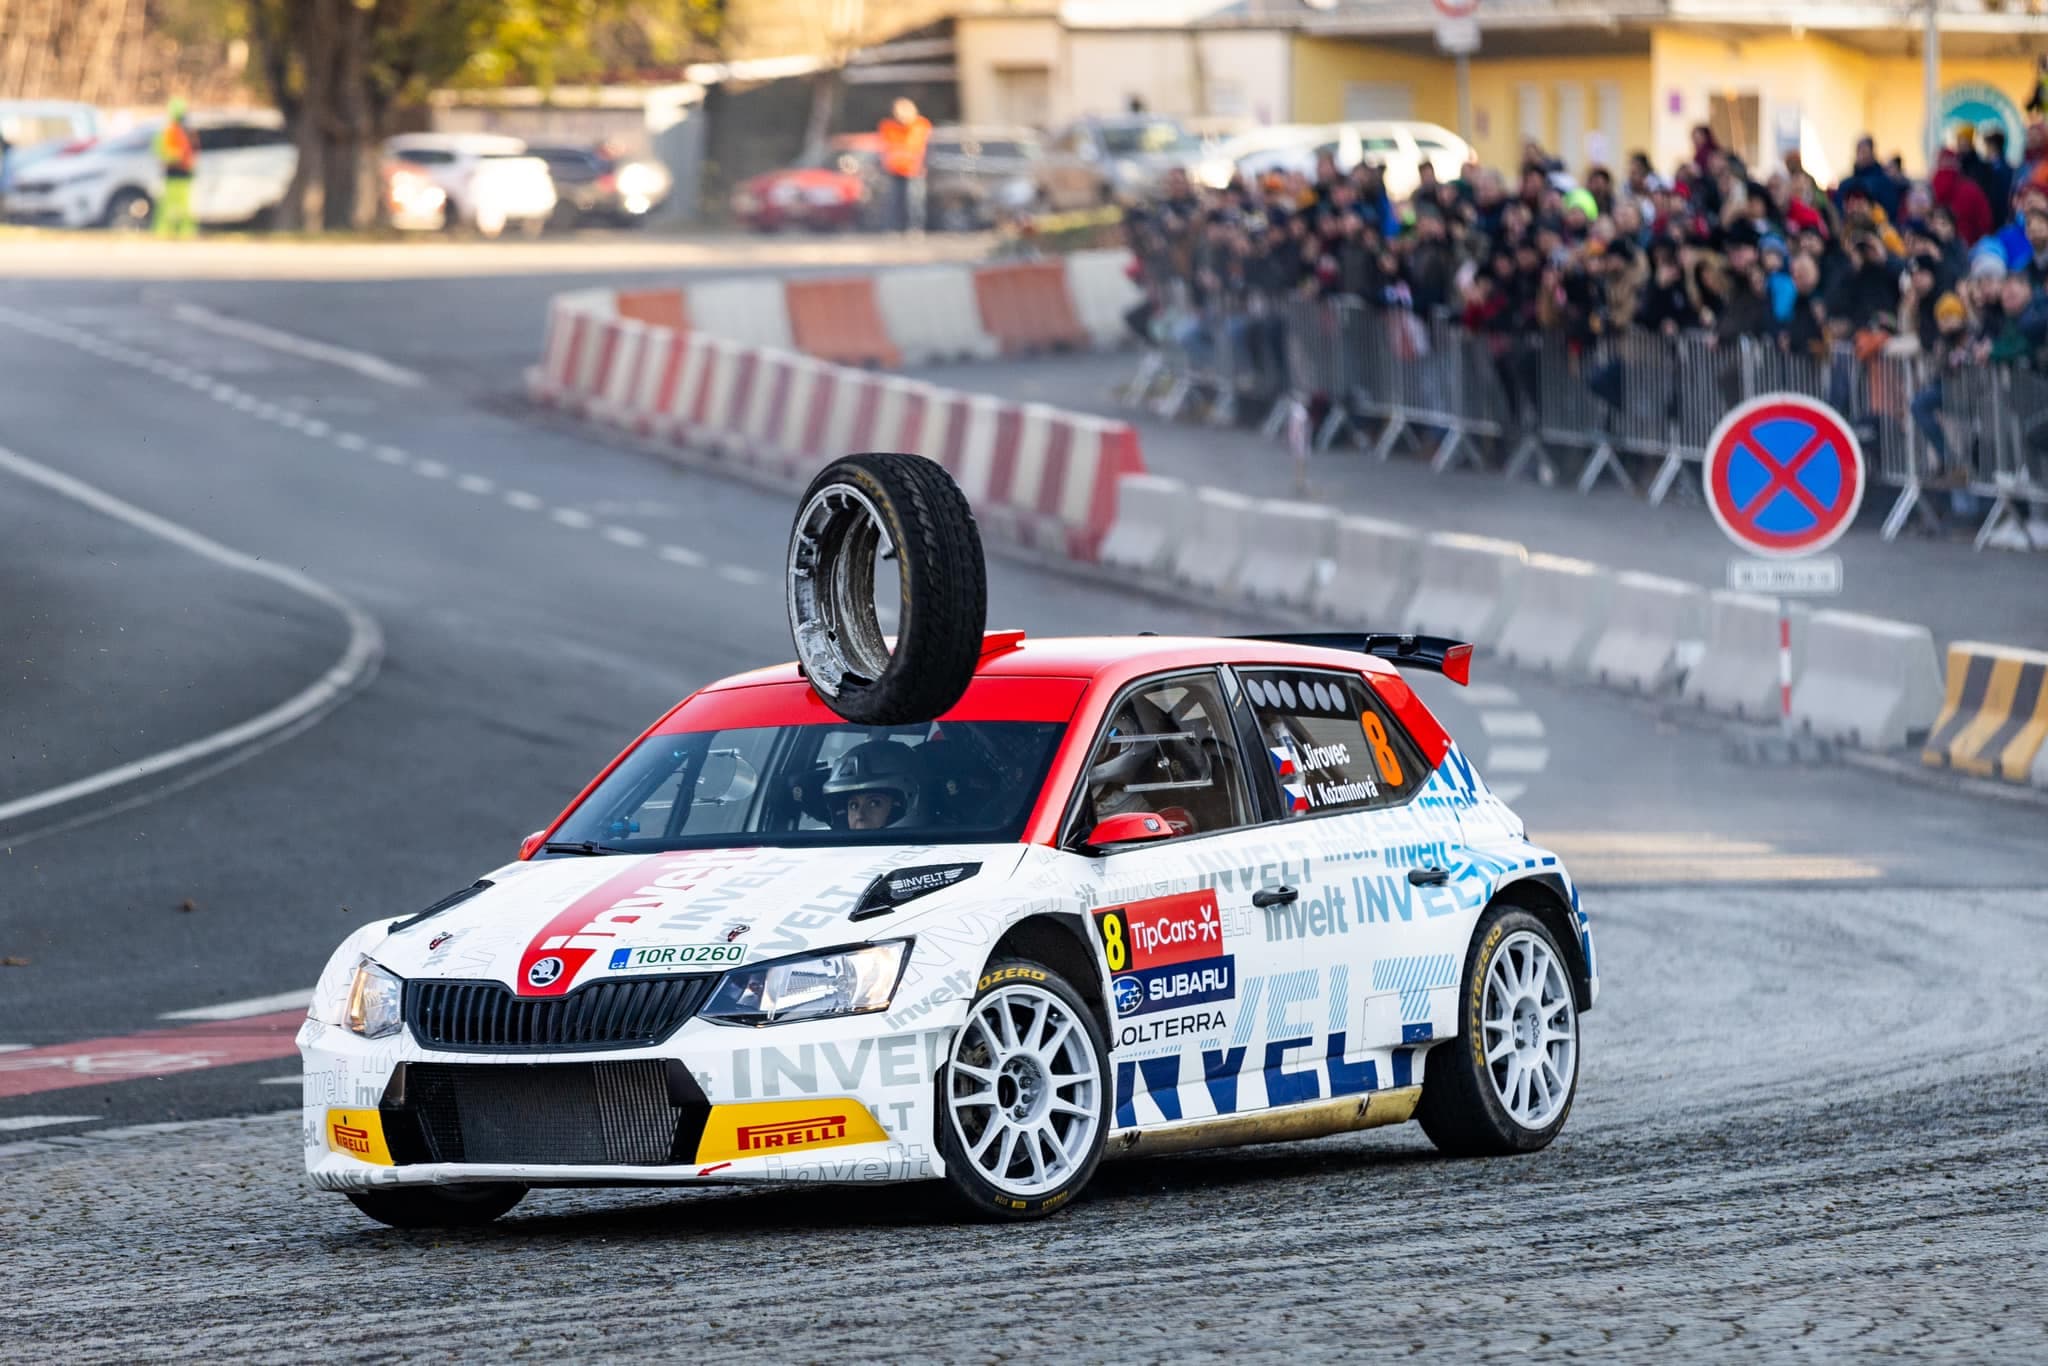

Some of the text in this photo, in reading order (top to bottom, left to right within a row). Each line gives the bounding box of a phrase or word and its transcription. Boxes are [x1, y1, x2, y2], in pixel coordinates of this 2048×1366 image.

[1361, 711, 1403, 786] 8
[903, 872, 945, 888] INVELT
[1103, 913, 1125, 971] 8
[1130, 917, 1197, 954] TipCars
[611, 961, 625, 969] CZ
[636, 946, 742, 964] 10R 0260
[881, 968, 973, 1031] invelt
[1149, 967, 1228, 1001] SUBARU
[333, 1123, 370, 1153] PIRELLI
[736, 1115, 847, 1151] PIRELLI
